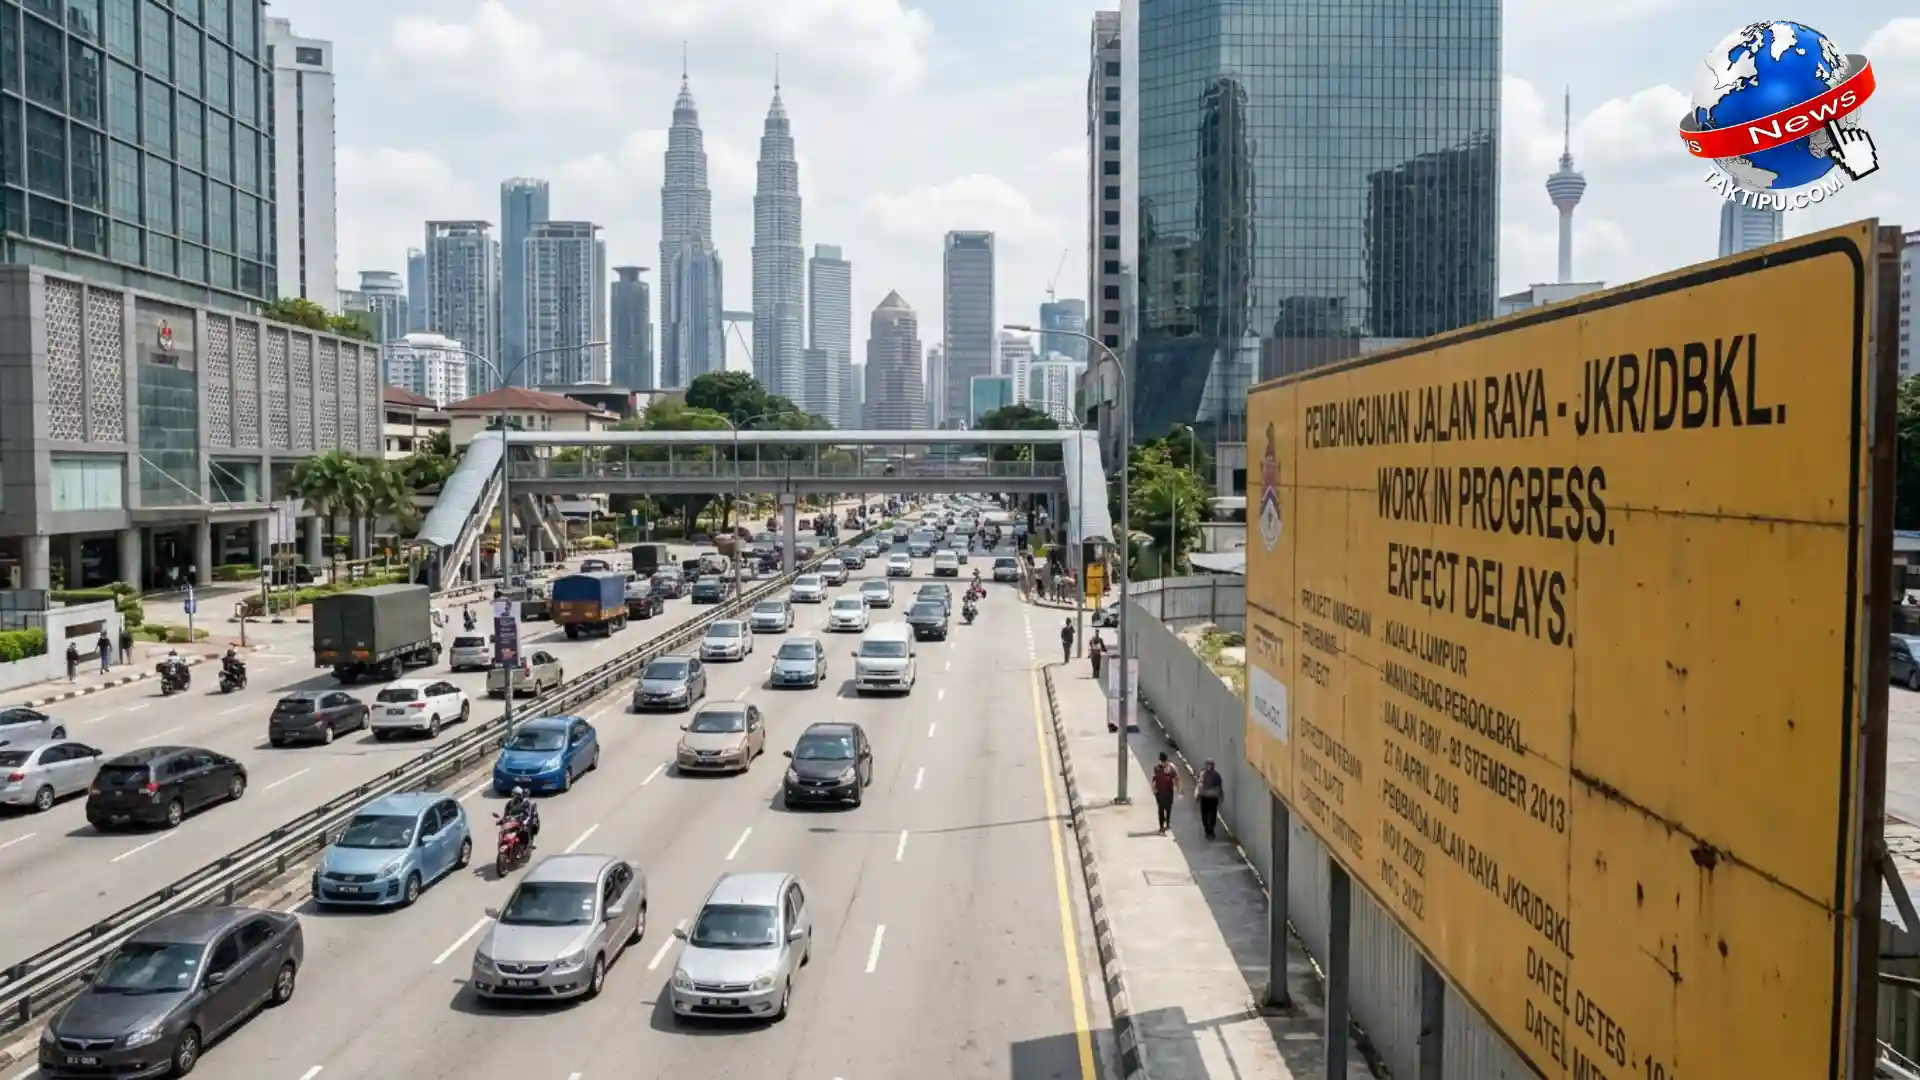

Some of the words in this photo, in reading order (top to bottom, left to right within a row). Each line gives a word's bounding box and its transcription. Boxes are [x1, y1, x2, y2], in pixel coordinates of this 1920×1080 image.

[1305, 390, 1410, 449] PEMBANGUNAN
[1413, 379, 1477, 442] JALAN
[1485, 368, 1549, 440] RAYA
[1575, 333, 1786, 437] JKR/DBKL.
[1377, 467, 1428, 519] WORK
[1433, 467, 1452, 526] IN
[1459, 466, 1615, 546] PROGRESS.
[1388, 542, 1460, 614] EXPECT
[1466, 556, 1574, 649] DELAYS.
[1386, 619, 1418, 658] KUALA
[1420, 630, 1467, 677] LUMPUR
[1434, 772, 1459, 815] 2018
[1530, 783, 1566, 834] 2013
[1431, 817, 1466, 870] JALAN
[1468, 843, 1500, 898] RAYA
[1526, 945, 1570, 1017] DATEL
[1575, 988, 1626, 1068] DETES
